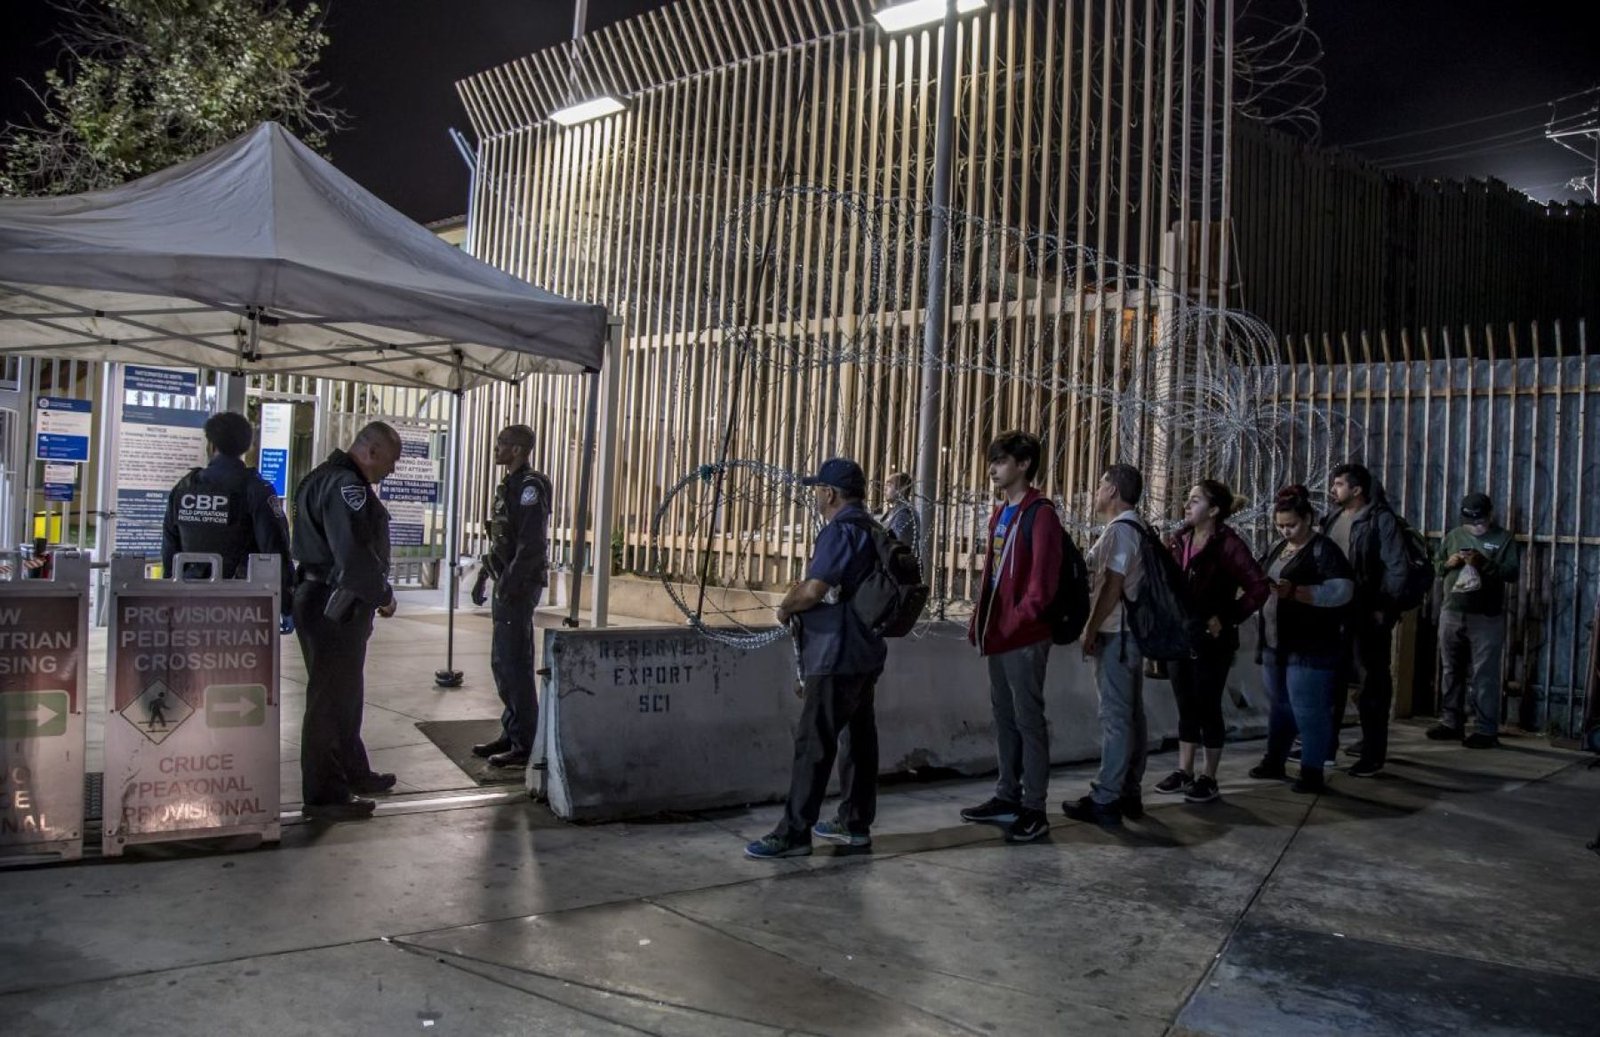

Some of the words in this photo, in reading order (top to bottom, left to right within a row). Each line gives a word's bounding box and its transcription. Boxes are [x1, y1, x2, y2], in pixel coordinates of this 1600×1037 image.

[181, 494, 228, 510] CBP
[124, 606, 269, 624] PROVISIONAL
[121, 629, 269, 648] PEDESTRIAN
[600, 639, 706, 658] RESERVED
[134, 652, 257, 671] CROSSING
[614, 666, 693, 686] EXPORT
[639, 694, 670, 712] SCI
[159, 753, 233, 774] CRUCE
[138, 776, 252, 798] PEATONAL
[124, 798, 266, 822] PROVISIONAL
